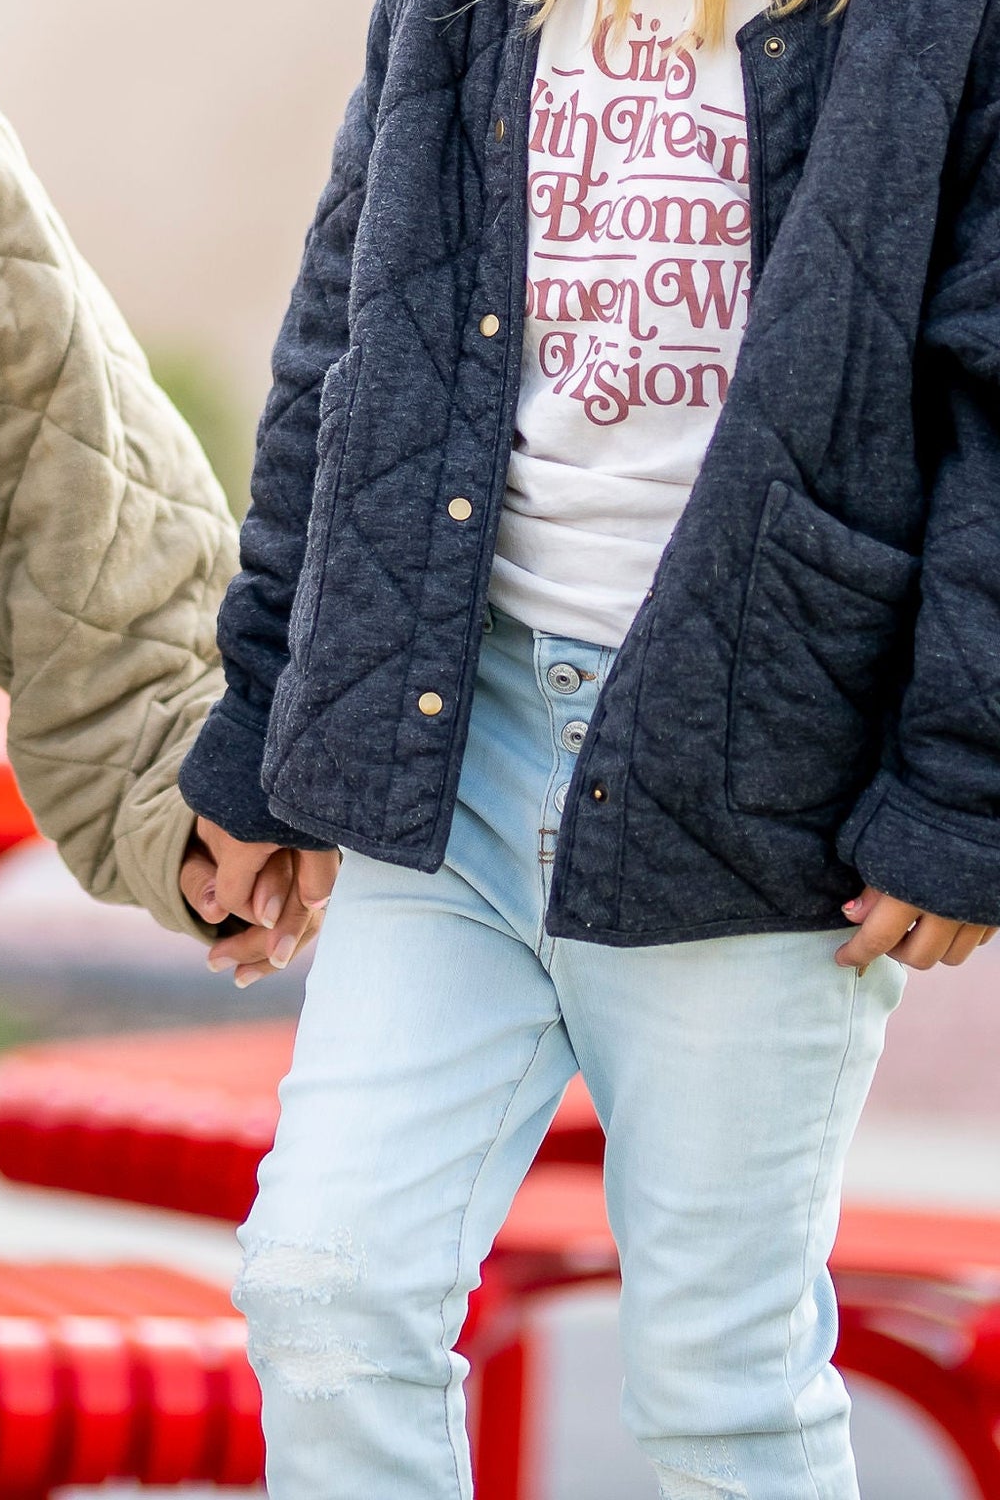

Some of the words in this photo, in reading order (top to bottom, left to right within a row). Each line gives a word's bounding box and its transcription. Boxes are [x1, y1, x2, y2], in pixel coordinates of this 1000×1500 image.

[592, 12, 704, 100] Girs
[529, 78, 608, 187] ith
[528, 171, 751, 246] Become
[525, 277, 658, 341] men
[539, 331, 729, 426] Vision
